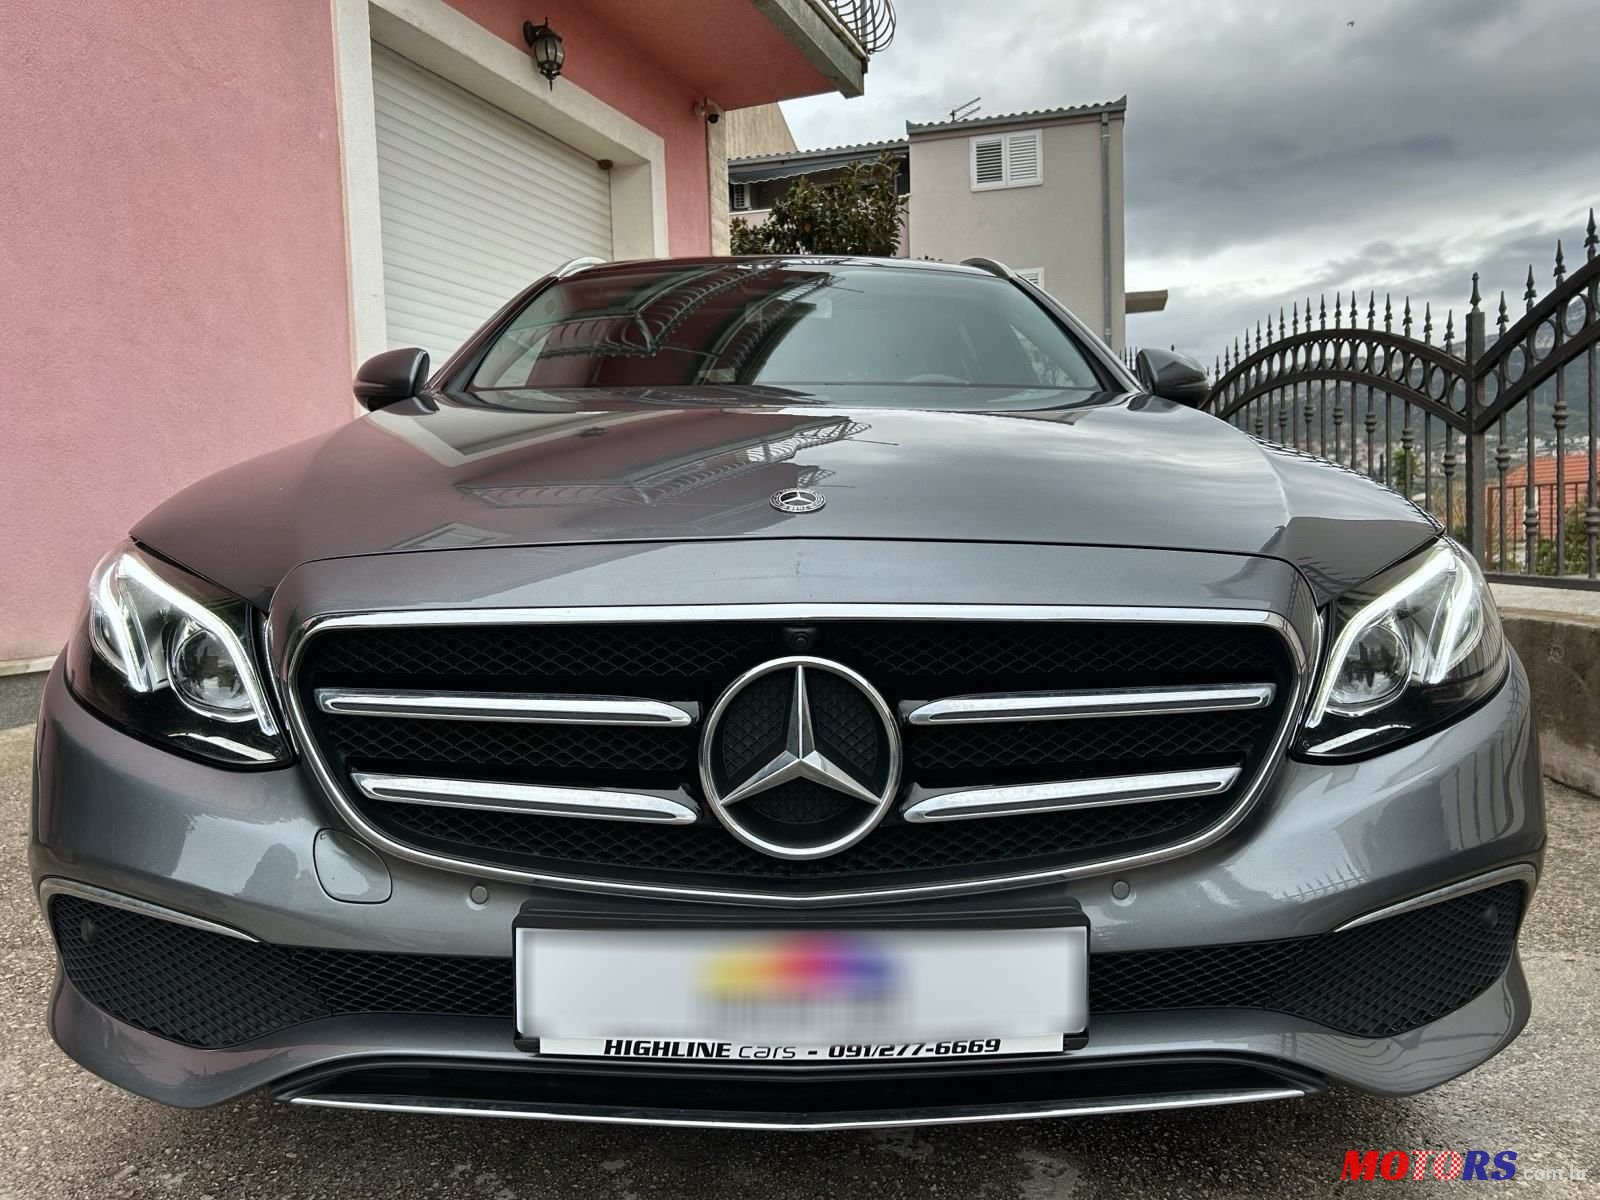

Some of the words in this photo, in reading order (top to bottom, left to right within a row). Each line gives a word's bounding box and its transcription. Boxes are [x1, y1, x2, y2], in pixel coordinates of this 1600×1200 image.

[604, 1039, 732, 1058] HIGHLINE
[738, 1046, 797, 1059] cars
[828, 1038, 1002, 1058] 091/277-6669
